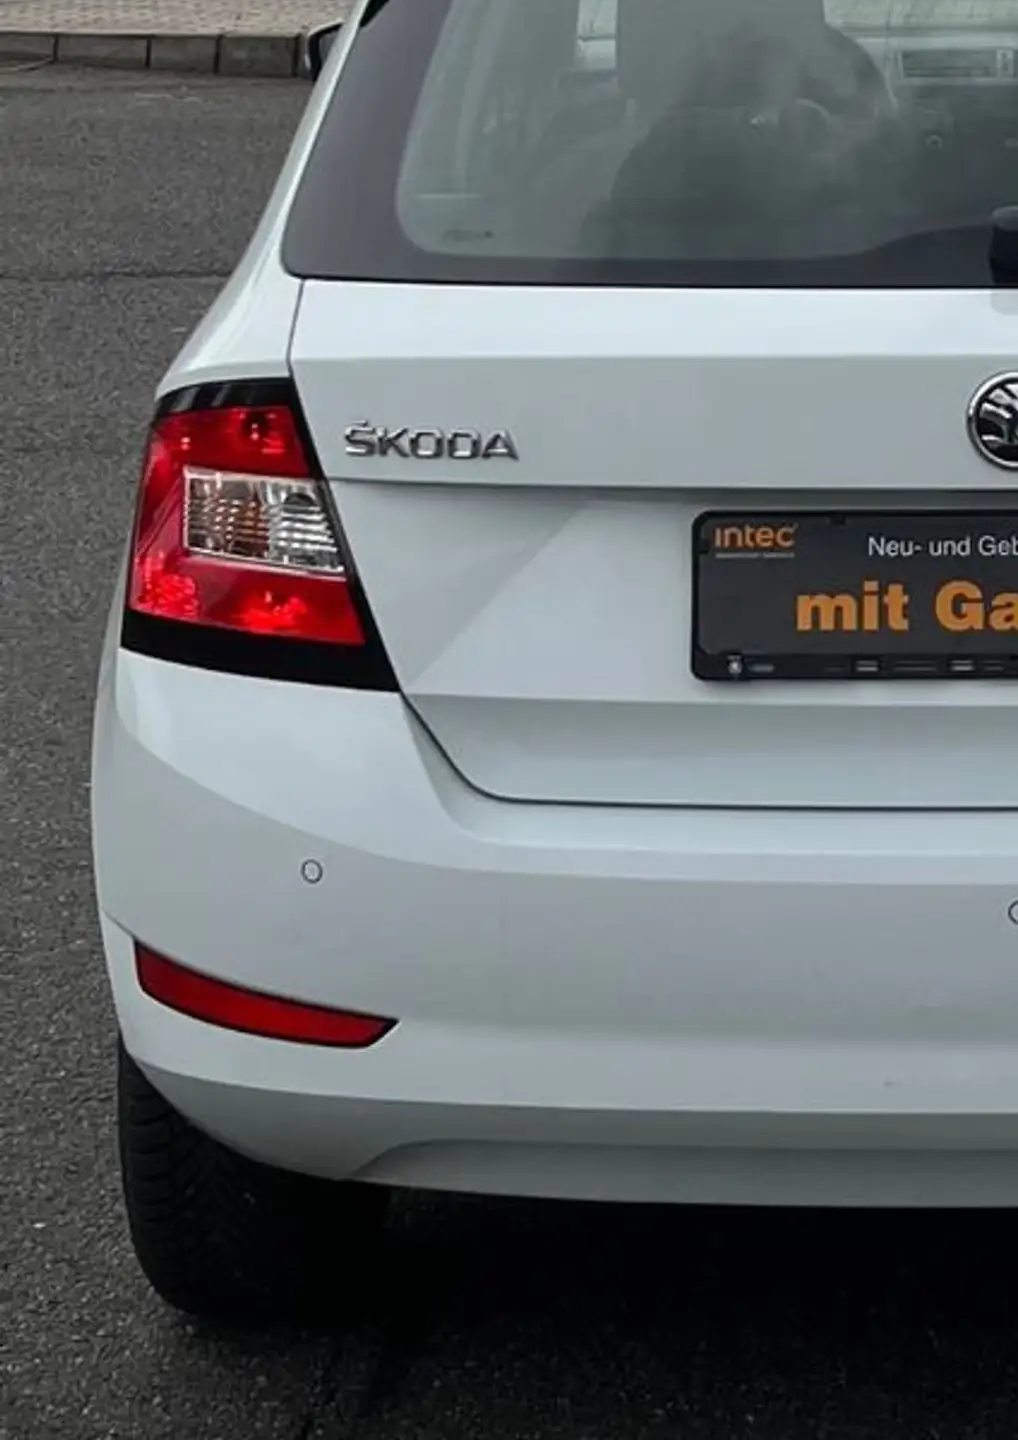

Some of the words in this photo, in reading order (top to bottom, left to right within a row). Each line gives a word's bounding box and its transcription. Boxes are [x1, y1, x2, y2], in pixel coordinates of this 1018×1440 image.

[715, 524, 796, 548] intec
[868, 536, 922, 557] Neu-
[929, 536, 971, 556] und
[796, 580, 909, 631] mit
